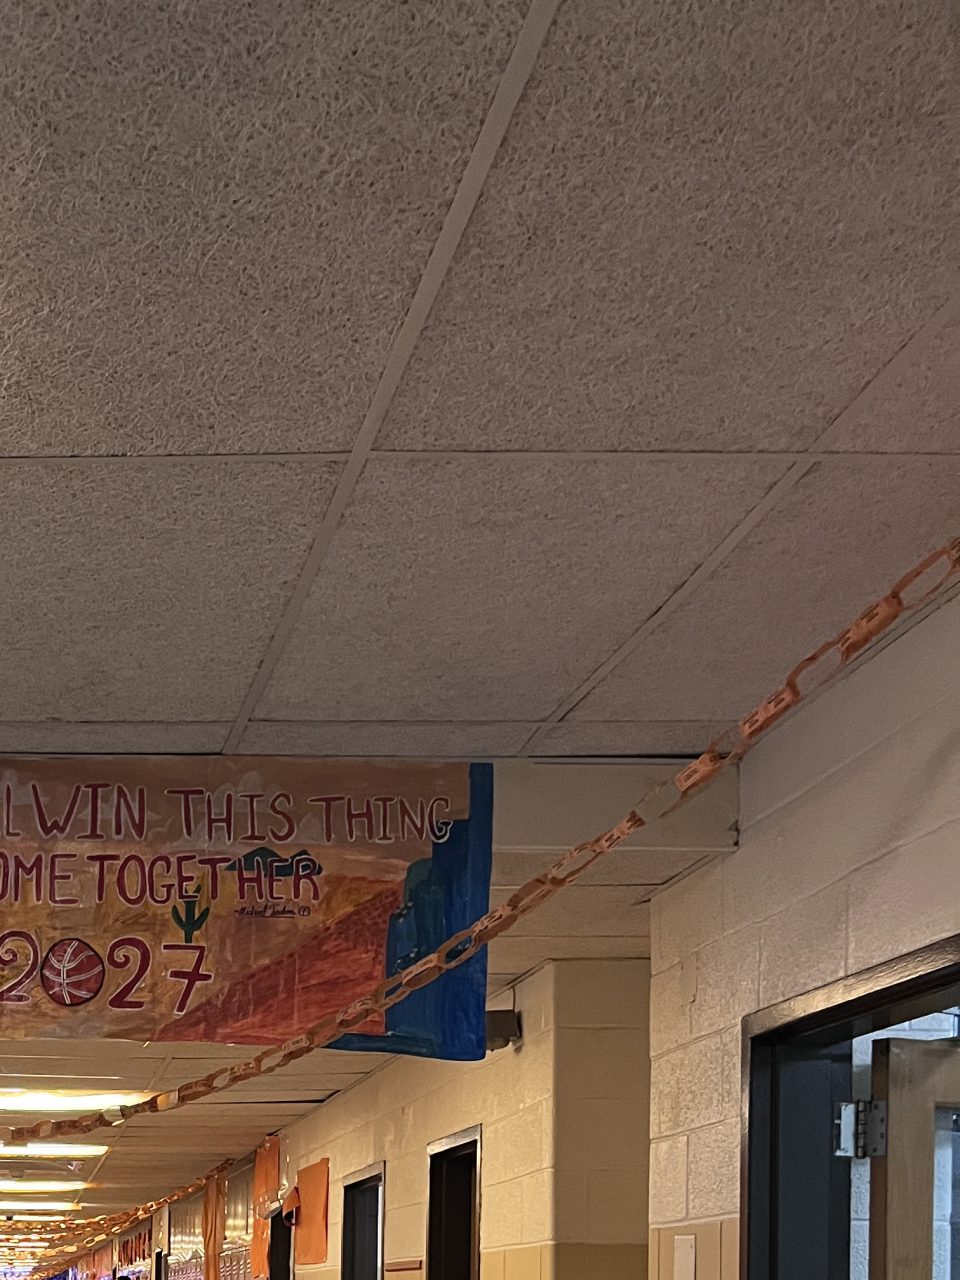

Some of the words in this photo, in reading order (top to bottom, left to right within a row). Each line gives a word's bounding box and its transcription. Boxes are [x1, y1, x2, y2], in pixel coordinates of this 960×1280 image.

[30, 782, 147, 841] WIN
[164, 787, 294, 844] THIS
[308, 795, 454, 844] THING
[86, 853, 323, 906] TOGETHER
